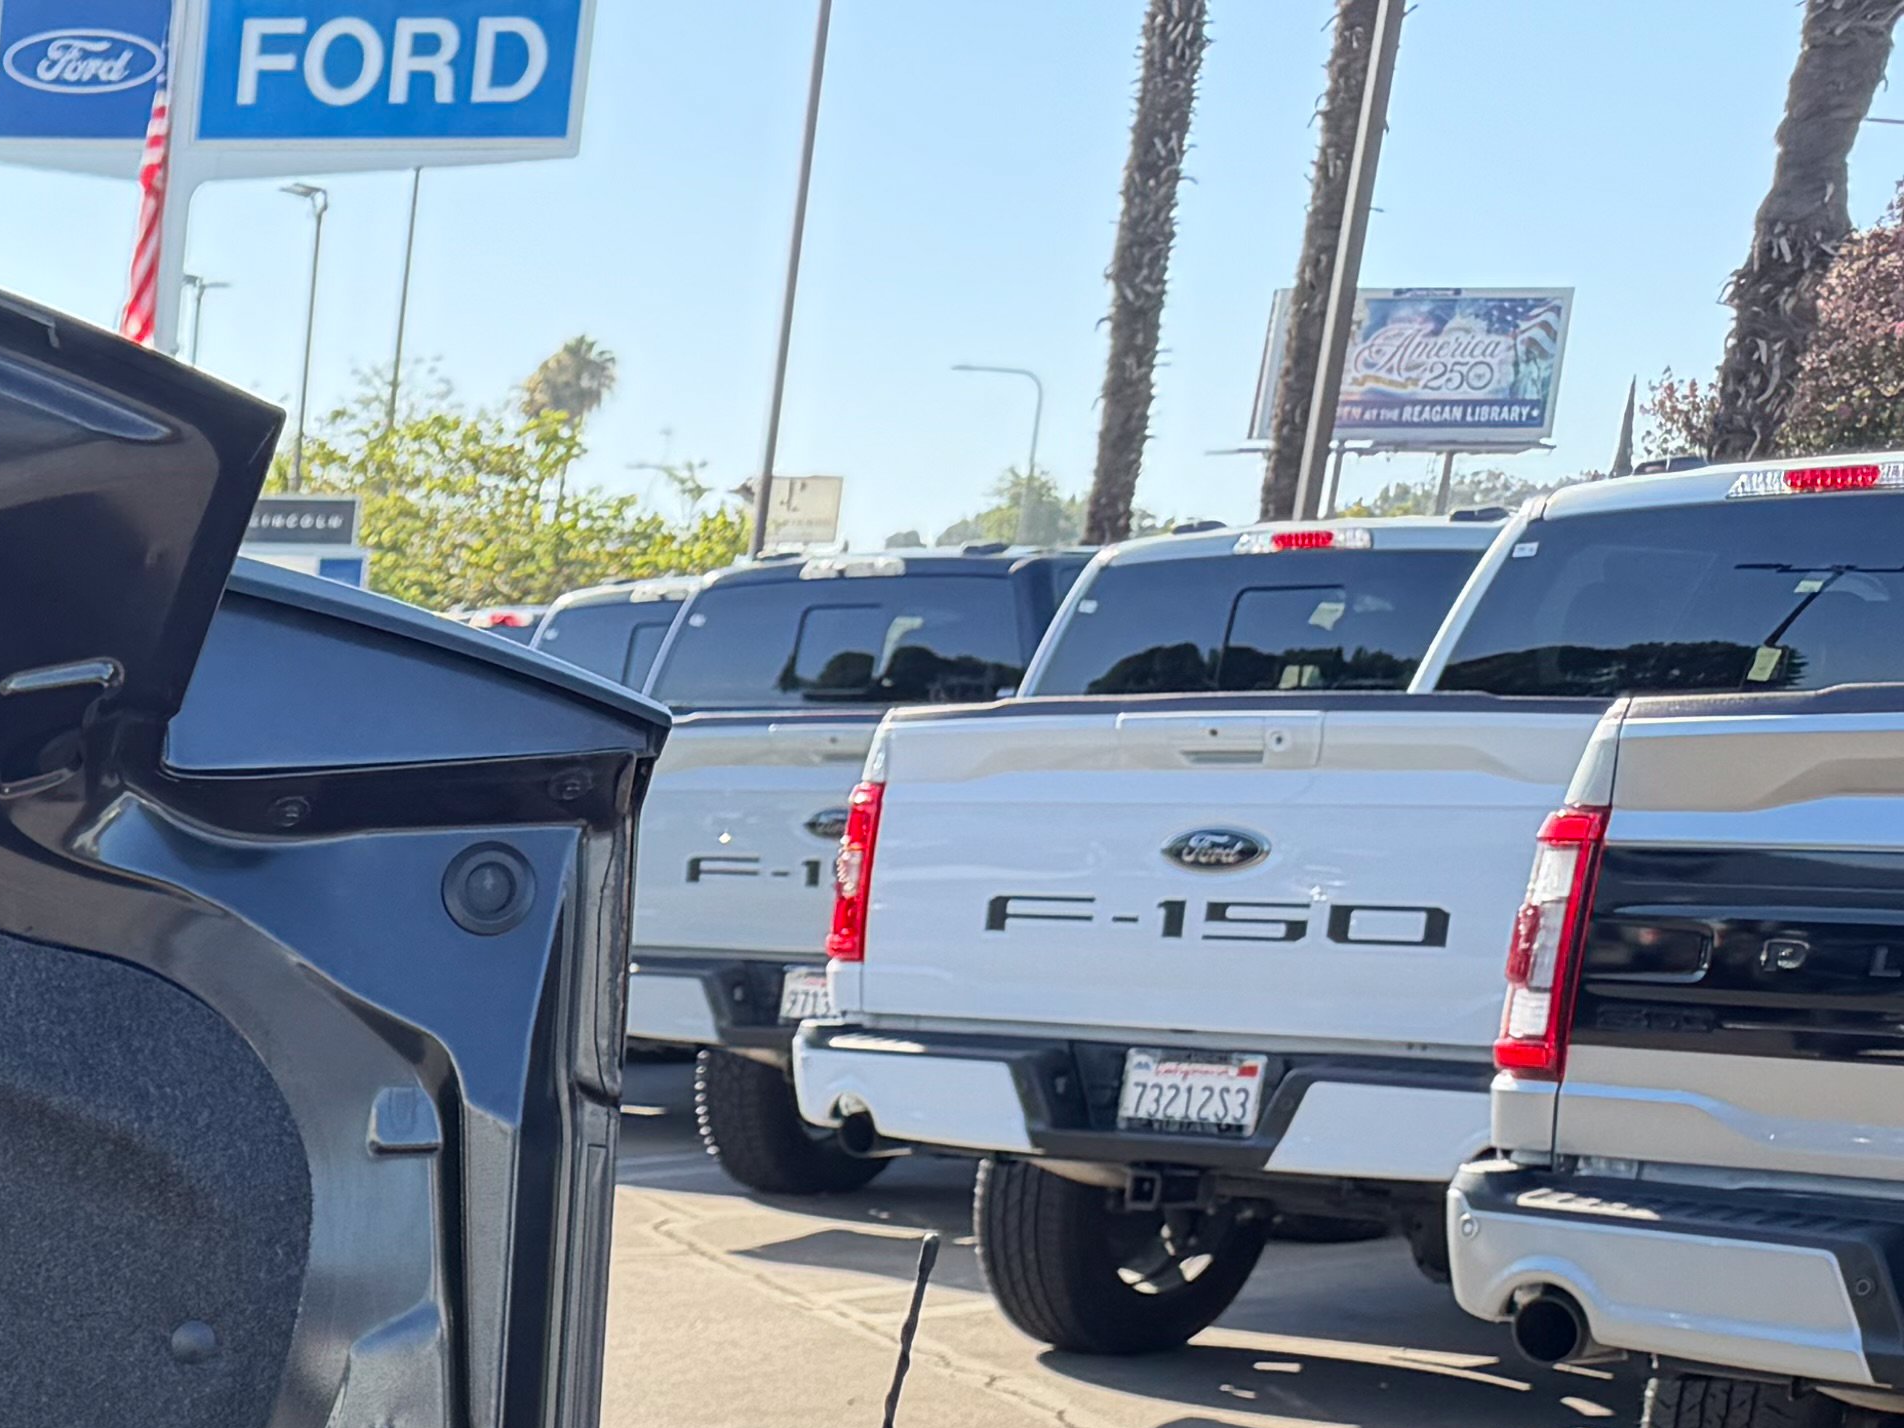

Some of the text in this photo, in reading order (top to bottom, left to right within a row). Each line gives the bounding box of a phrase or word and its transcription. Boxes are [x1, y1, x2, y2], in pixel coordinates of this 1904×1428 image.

[36, 38, 134, 82] Ford
[236, 16, 549, 107] FORD
[1354, 323, 1502, 379] America
[1423, 360, 1495, 391] 250
[1401, 405, 1463, 422] REAGAN
[1465, 405, 1529, 422] LIBRARY
[1182, 833, 1243, 864] Ford
[985, 895, 1451, 948] F-150
[1132, 1081, 1250, 1123] 73212S3
